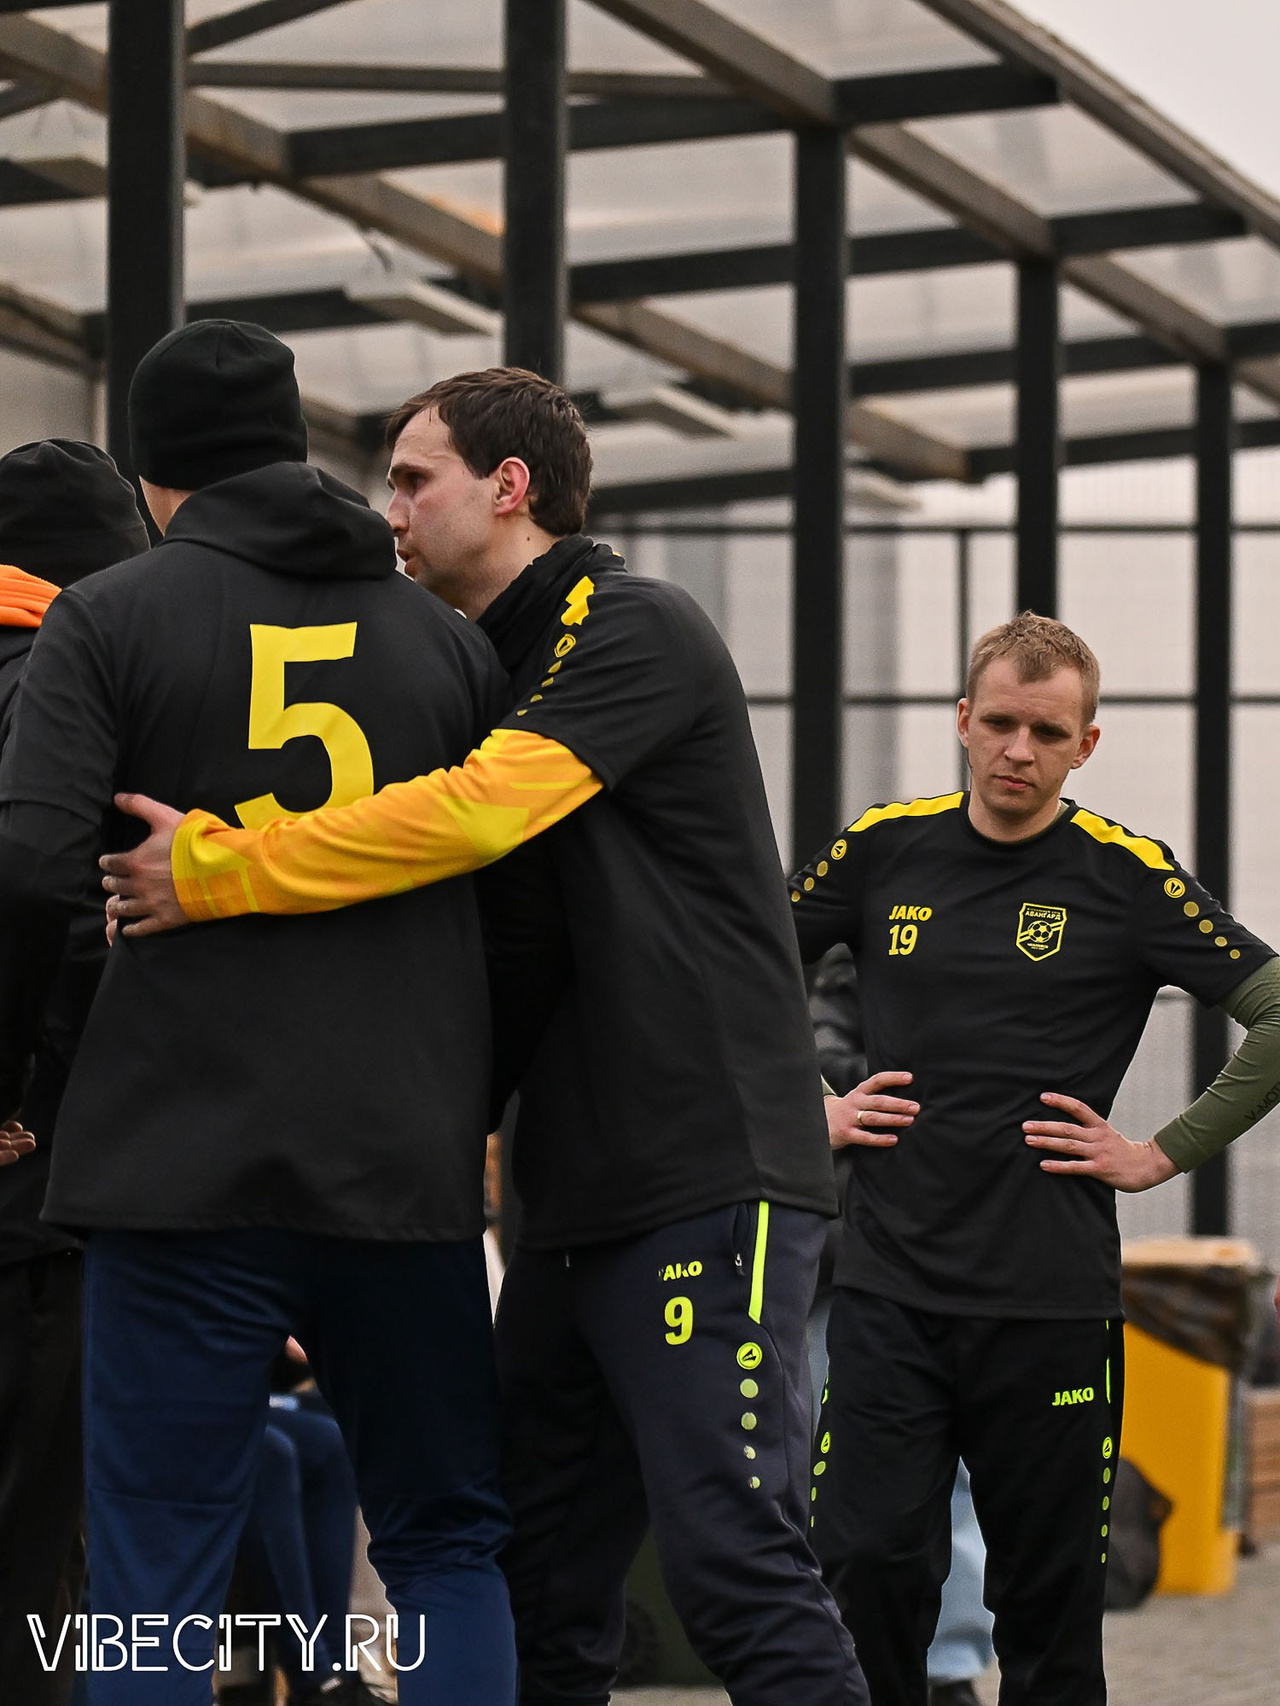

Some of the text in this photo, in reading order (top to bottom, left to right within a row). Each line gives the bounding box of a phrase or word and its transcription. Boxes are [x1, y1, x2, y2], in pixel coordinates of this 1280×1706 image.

[234, 621, 375, 830] 5
[888, 904, 933, 922] JAKO
[888, 923, 919, 956] 19
[658, 1260, 703, 1282] AKO
[664, 1296, 694, 1346] 9
[1051, 1386, 1095, 1407] JAKO
